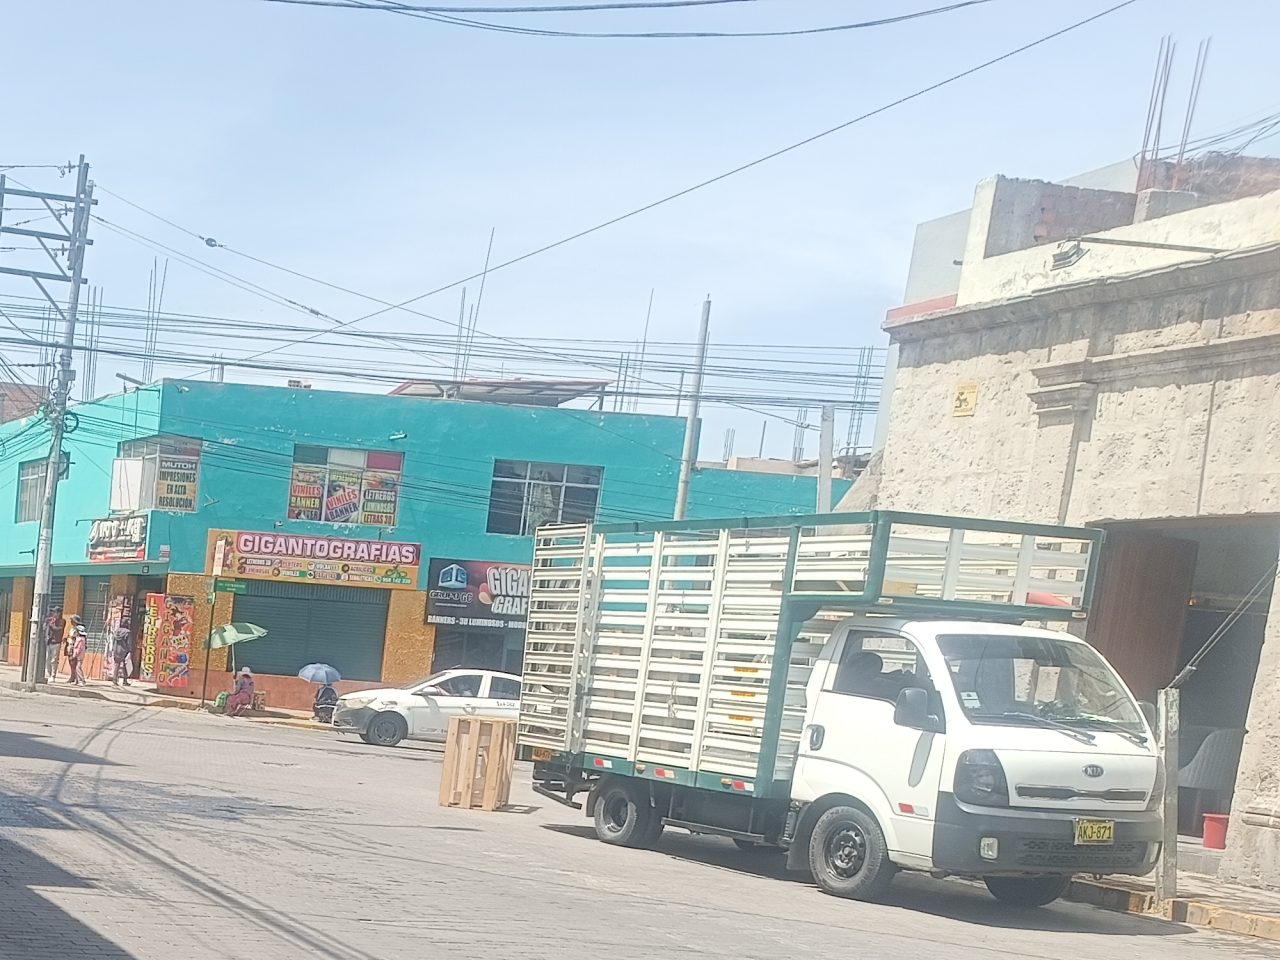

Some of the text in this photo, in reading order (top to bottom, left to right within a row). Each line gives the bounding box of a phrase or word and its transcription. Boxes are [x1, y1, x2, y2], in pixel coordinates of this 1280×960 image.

[161, 461, 196, 470] MUTOH
[160, 470, 196, 483] IMPRESIONES
[174, 485, 187, 495] ALTA
[292, 485, 321, 496] VINILES
[365, 489, 396, 501] LETREROS
[327, 490, 358, 508] VINILES
[329, 502, 359, 520] BANNER
[363, 513, 383, 524] LETRAS
[239, 534, 415, 563] GIGANTOGRAFIAS
[487, 567, 532, 596] GIGA
[144, 597, 160, 674] LETREROS
[1087, 766, 1102, 776] KIA
[1077, 825, 1113, 840] AKJ-871
